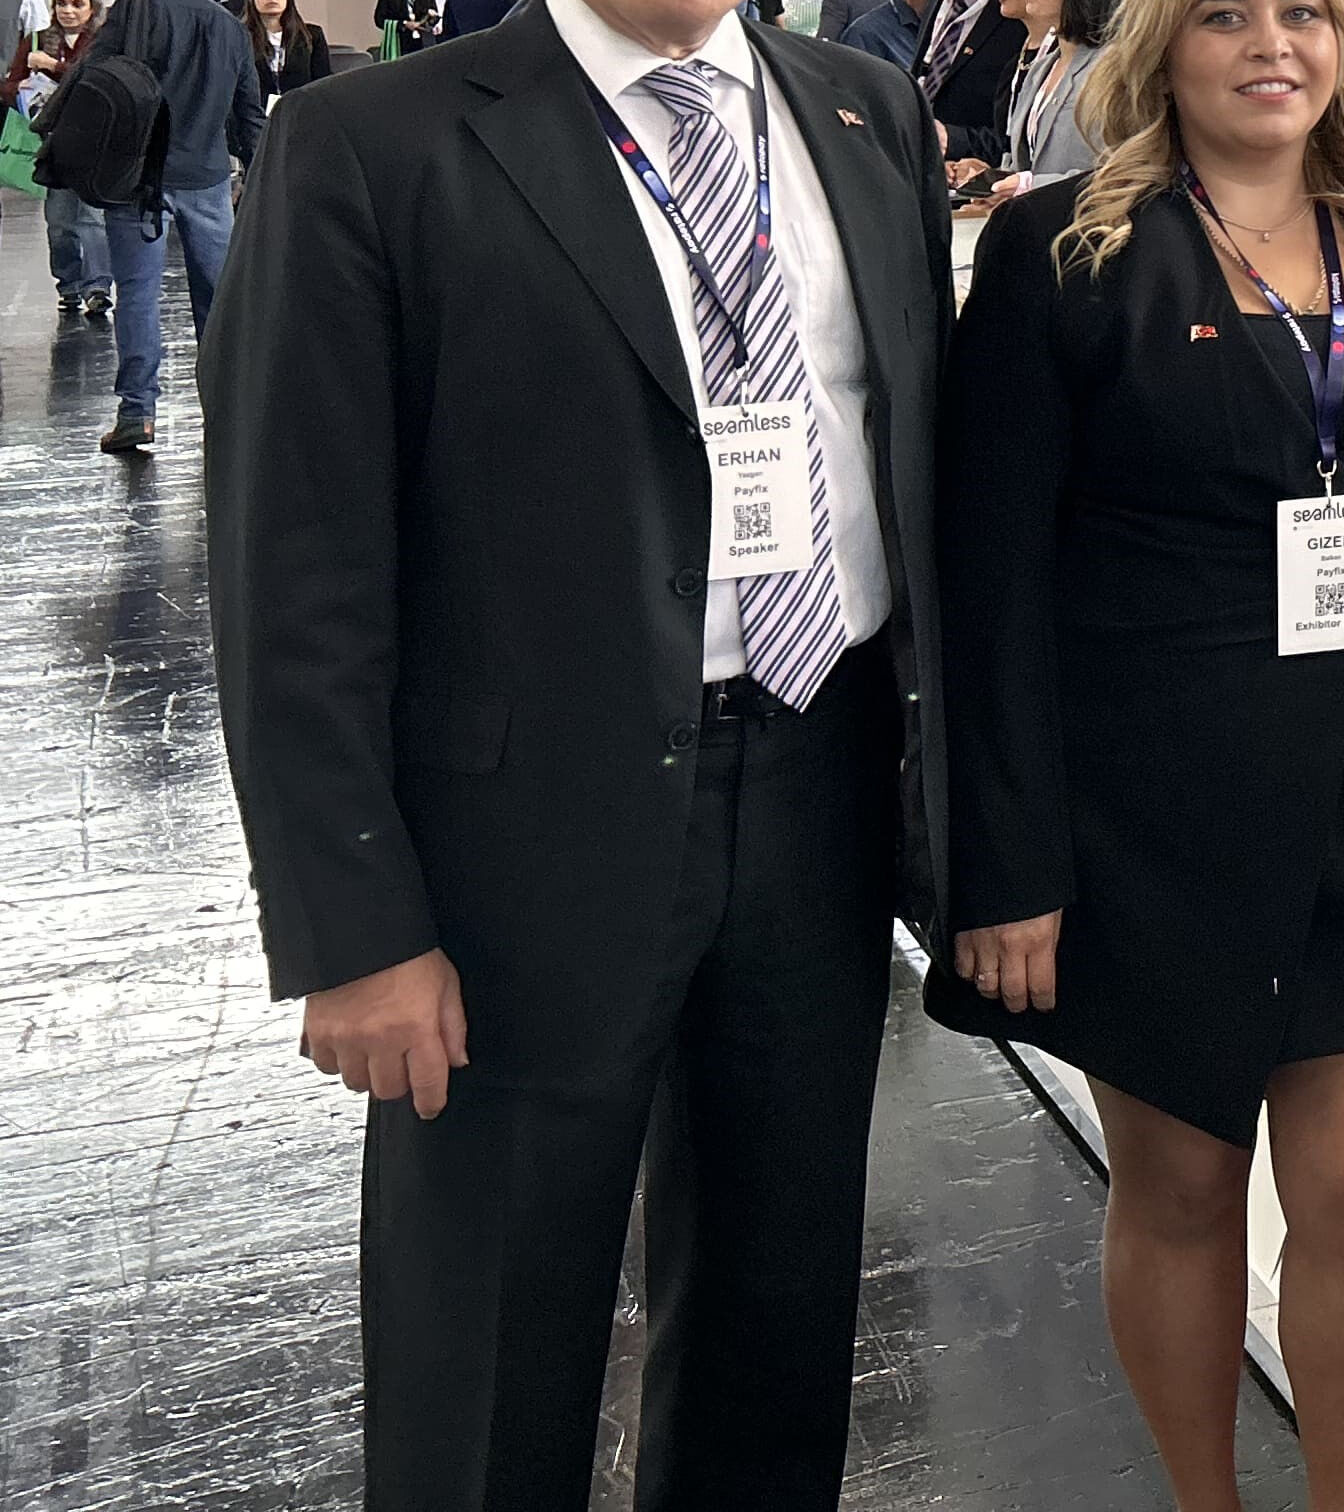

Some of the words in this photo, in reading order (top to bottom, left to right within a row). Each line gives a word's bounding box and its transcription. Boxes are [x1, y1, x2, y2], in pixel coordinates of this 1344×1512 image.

[703, 414, 791, 436] seamless
[718, 448, 781, 467] ERHAN
[729, 542, 779, 557] Speaker
[1295, 619, 1341, 631] Exhibitor
